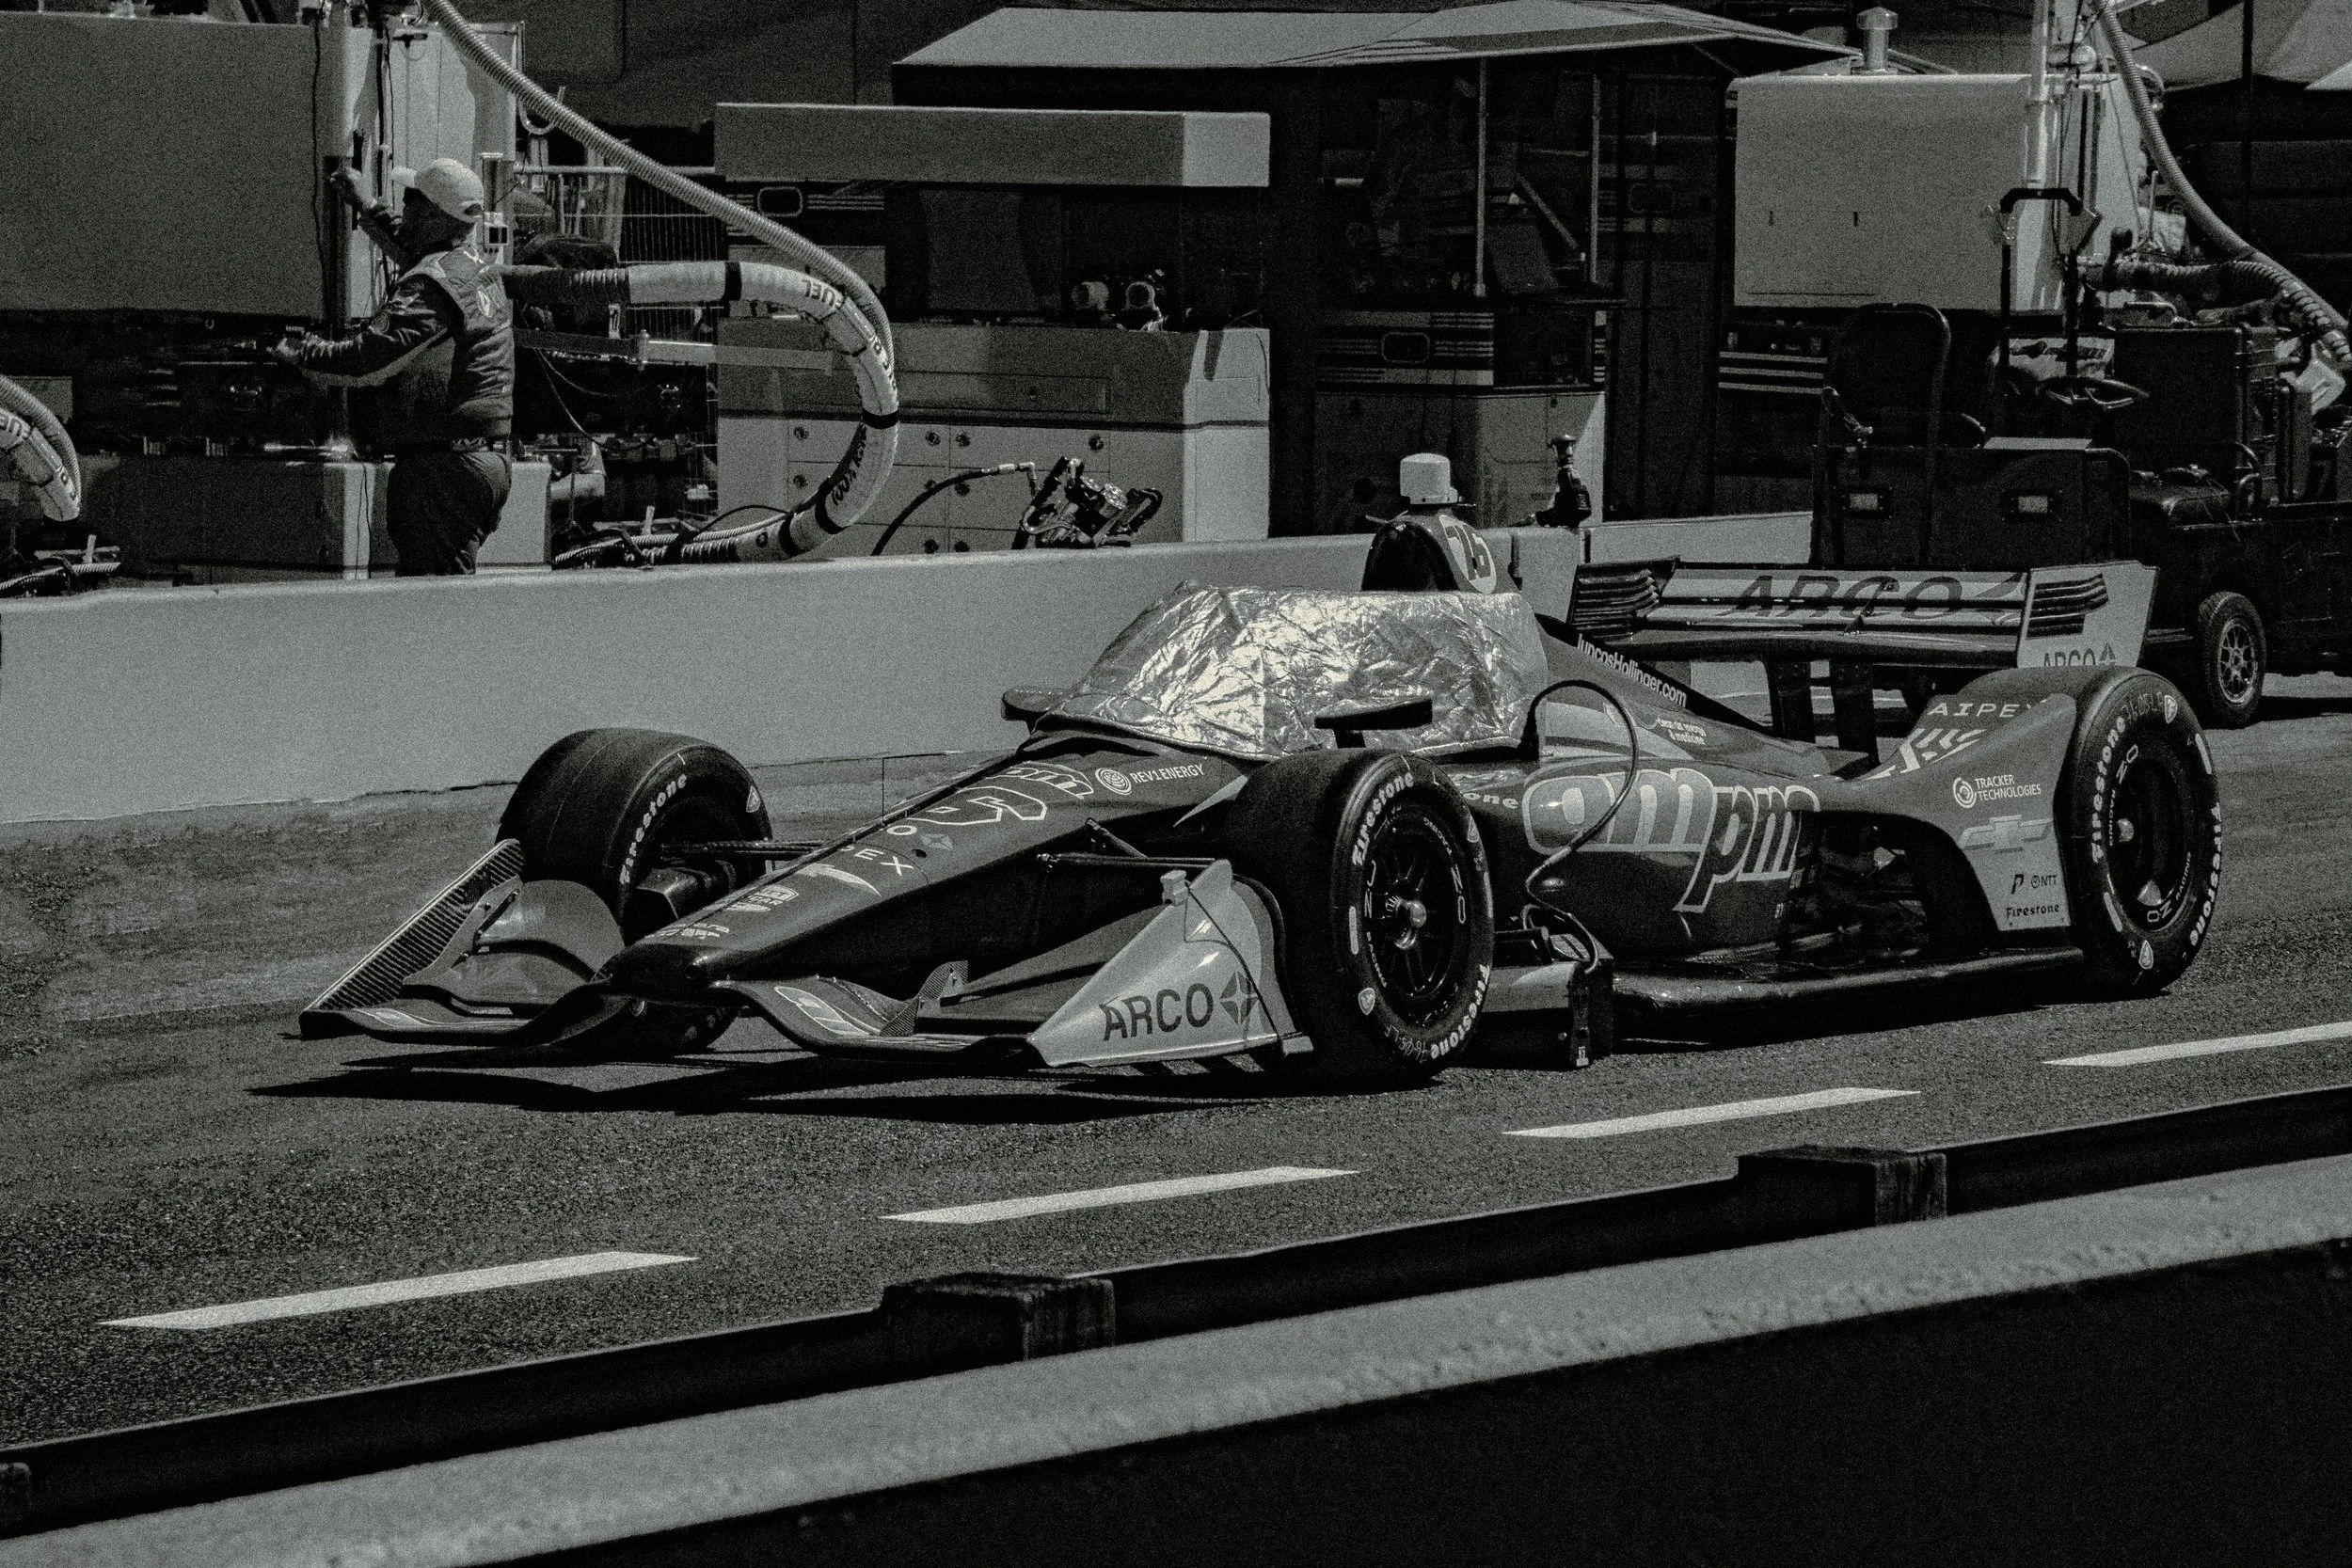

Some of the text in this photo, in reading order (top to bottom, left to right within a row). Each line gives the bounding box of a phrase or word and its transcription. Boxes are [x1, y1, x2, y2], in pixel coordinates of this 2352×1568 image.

[1714, 575, 1963, 620] ARCO
[1928, 699, 2047, 719] AIPE
[1975, 774, 2015, 790] TRACKER
[1978, 783, 2042, 801] TECHNOLOGIES
[2090, 716, 2127, 863] Firestone
[618, 773, 688, 885] Firestone
[1352, 770, 1415, 866] Firestone
[2041, 874, 2058, 887] NTT
[2005, 904, 2060, 920] Firestone
[1099, 983, 1215, 1041] ARCO
[1429, 963, 1490, 1060] Firestone
